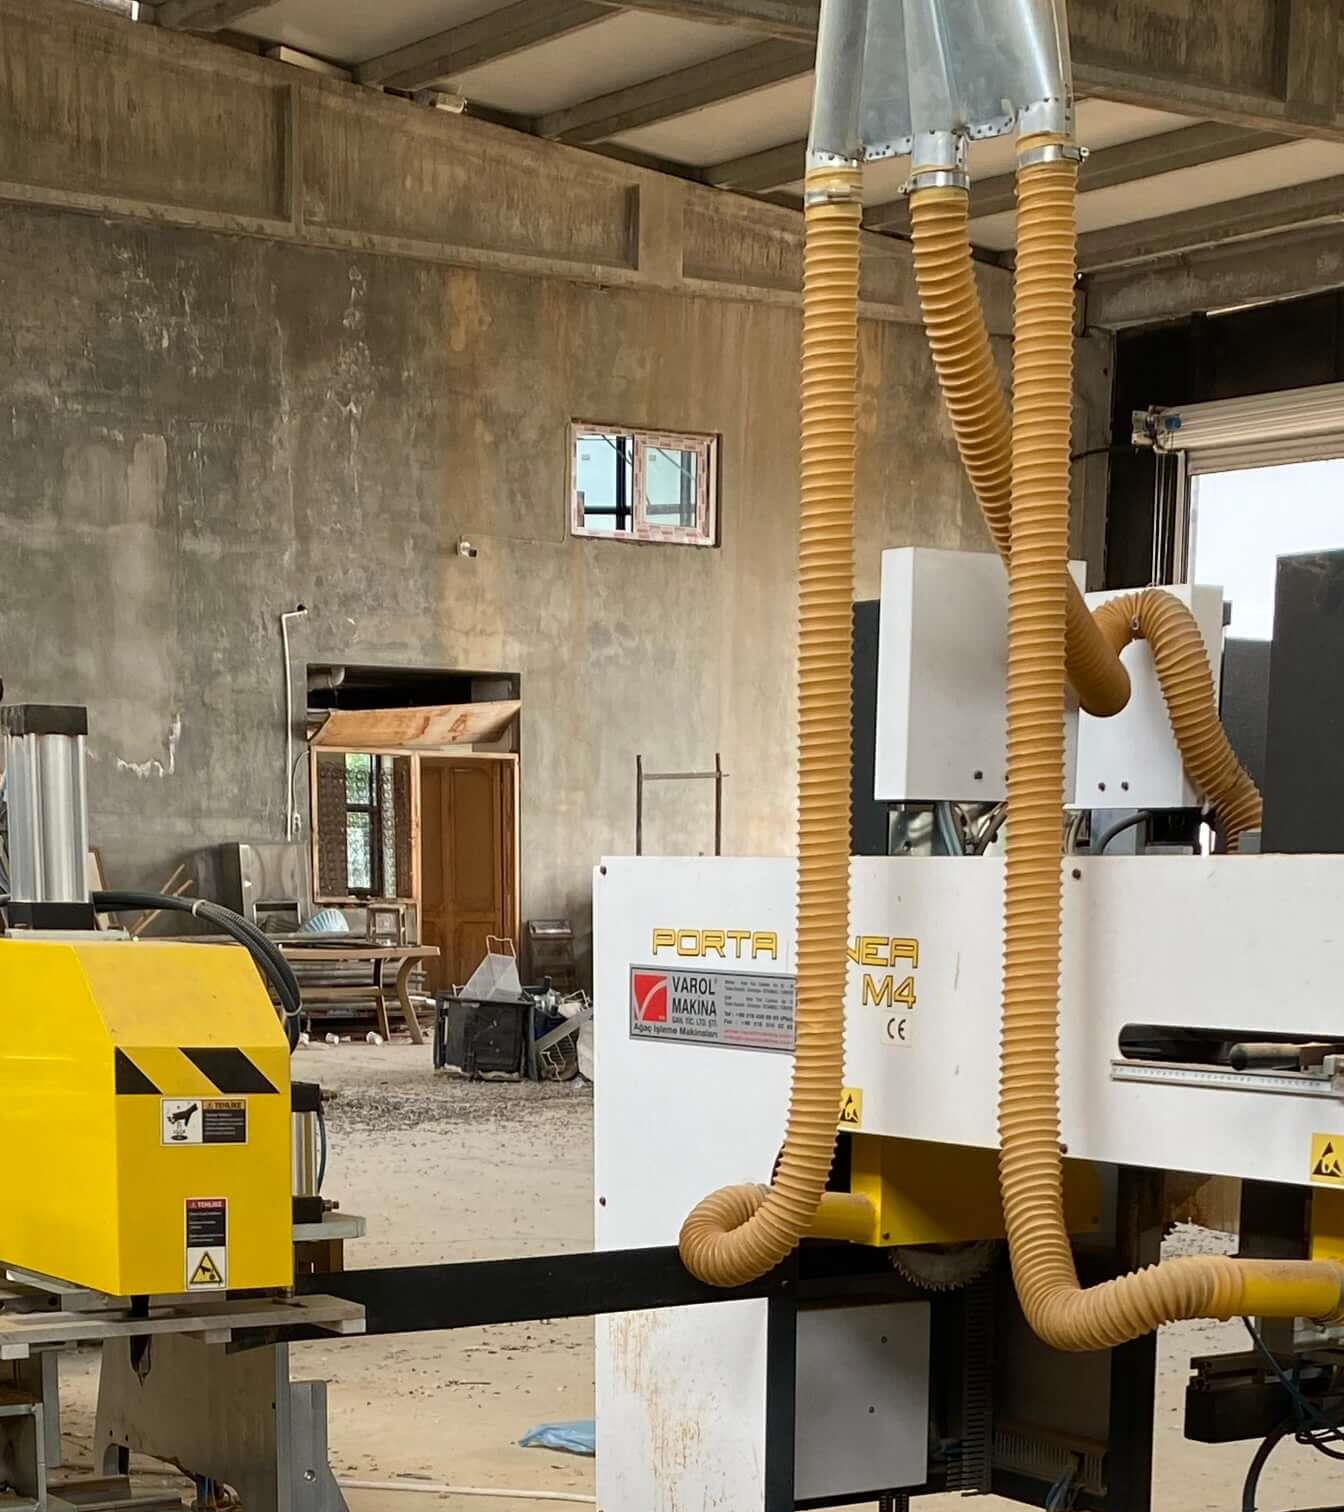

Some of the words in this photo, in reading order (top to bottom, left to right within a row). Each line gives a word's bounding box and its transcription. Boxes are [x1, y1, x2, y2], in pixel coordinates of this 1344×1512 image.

[652, 928, 779, 960] PORTA
[672, 975, 715, 995] VAROL
[862, 973, 917, 1009] M4
[887, 1017, 907, 1040] CE
